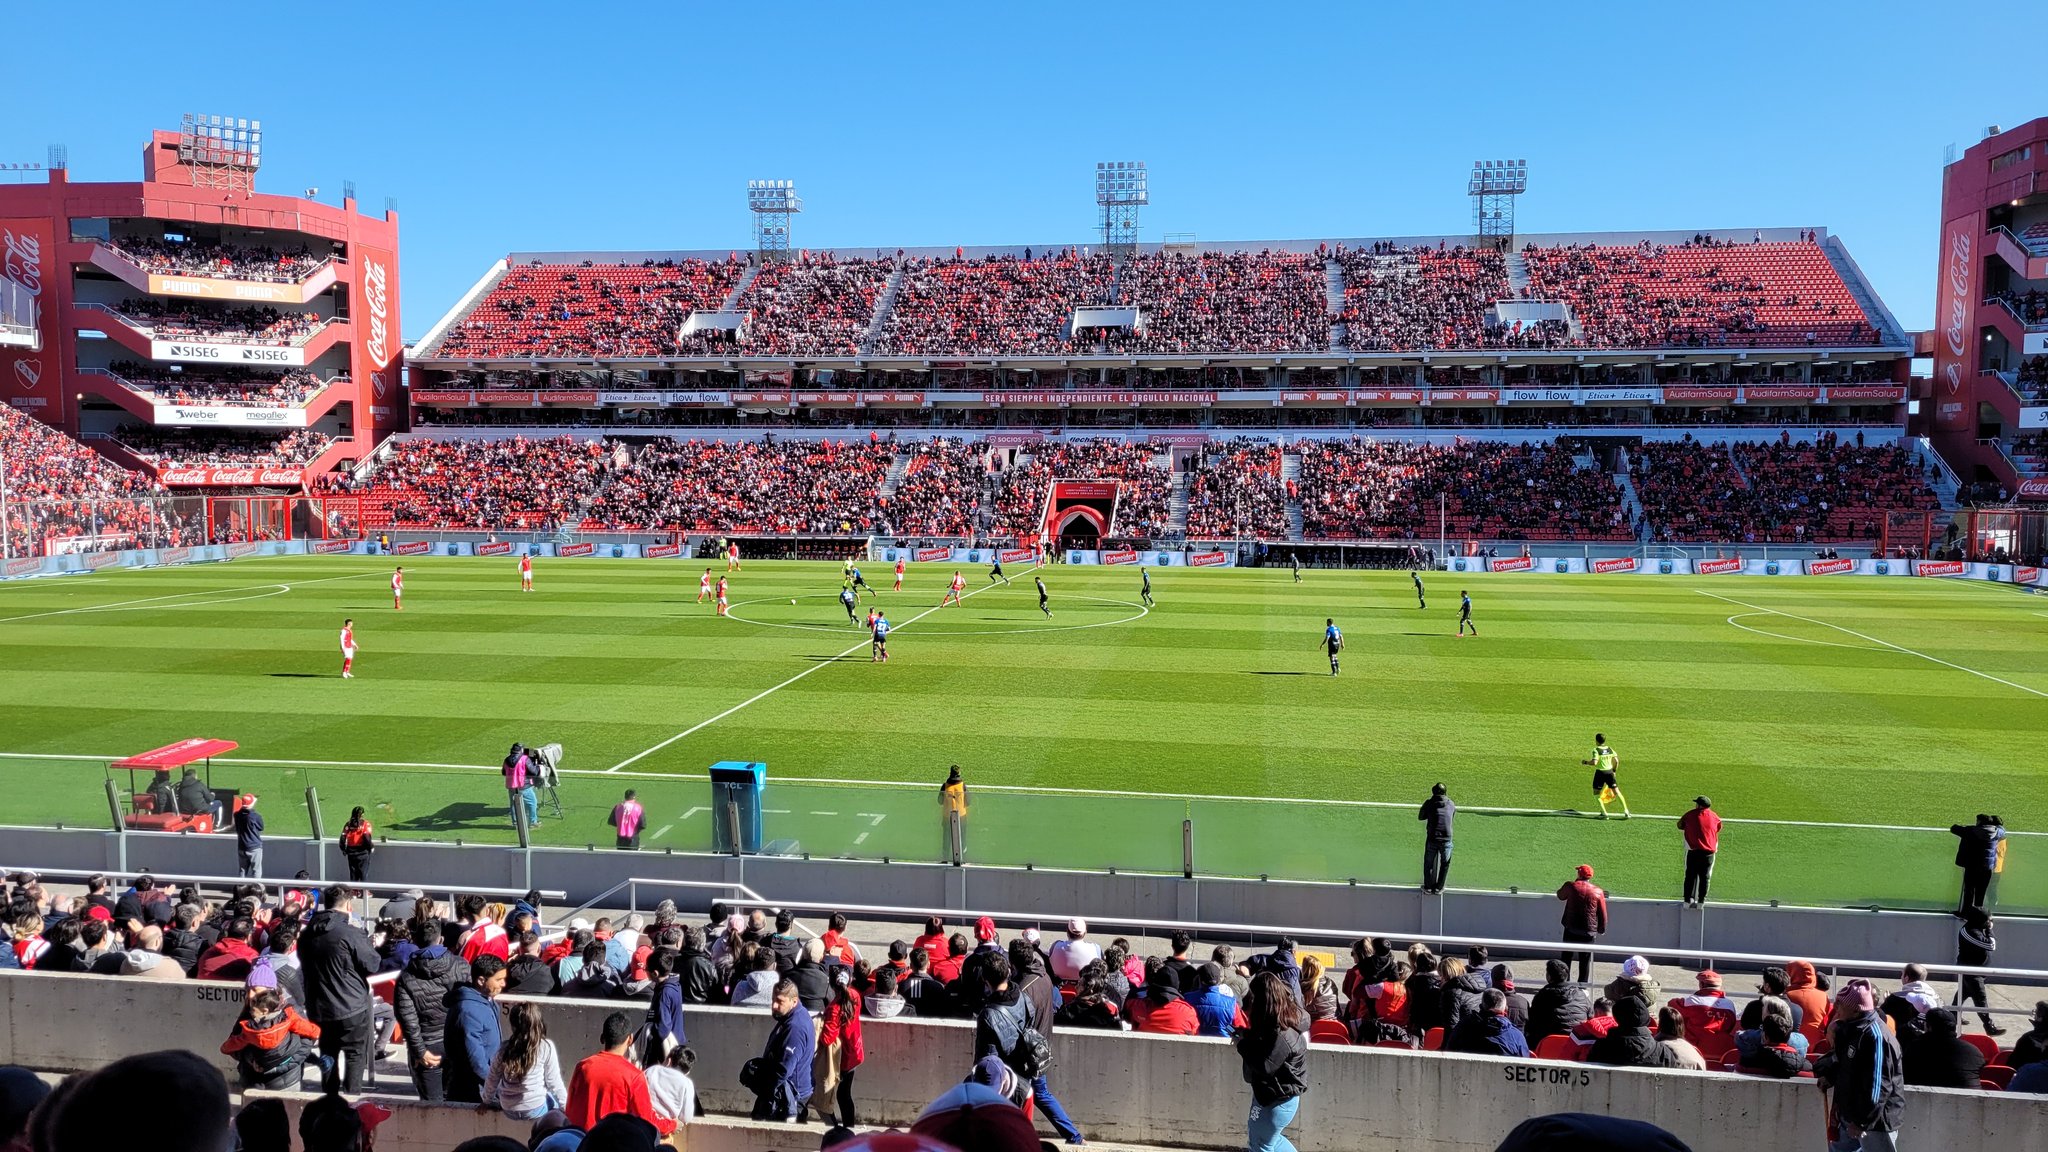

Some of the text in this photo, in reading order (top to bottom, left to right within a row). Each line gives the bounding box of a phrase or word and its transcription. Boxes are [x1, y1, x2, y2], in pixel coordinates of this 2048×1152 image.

[162, 279, 200, 294] PUMA
[236, 286, 273, 299] PUMA
[183, 346, 219, 358] SISEG
[255, 350, 288, 361] SISEG
[672, 393, 694, 402] flow
[699, 393, 720, 402] flow
[1047, 395, 1115, 403] INDEPENDIENTE,
[1132, 394, 1169, 402] ORGULLO
[1173, 394, 1215, 402] NACIONAL
[1514, 391, 1538, 399] flow
[1546, 391, 1570, 399] flow
[1669, 390, 1732, 398] AudifarmSalud
[1750, 390, 1814, 398] AudifarmSalud
[1833, 389, 1898, 398] AudifarmSalud
[184, 410, 218, 419] weber
[246, 411, 288, 421] megaflex
[317, 542, 348, 553] Schneider
[399, 542, 428, 554] Schneider
[481, 543, 509, 555] Schneider
[562, 544, 591, 556] Schneider
[649, 545, 678, 557] Schneider
[920, 549, 947, 561] Schneider
[1003, 550, 1031, 561] Schneider
[1107, 552, 1135, 563] Schneider
[1194, 554, 1223, 565] Schneider
[1495, 560, 1529, 571] Schneider
[1597, 560, 1633, 572] Schneider
[1702, 561, 1738, 573] Schneider
[1814, 561, 1850, 573] Schneider
[1921, 562, 1961, 575] Schneider
[724, 782, 743, 790] TCL
[197, 986, 246, 1002] SECTOR
[502, 1002, 509, 1015] 5
[1504, 1065, 1590, 1086] SECTOR 5
